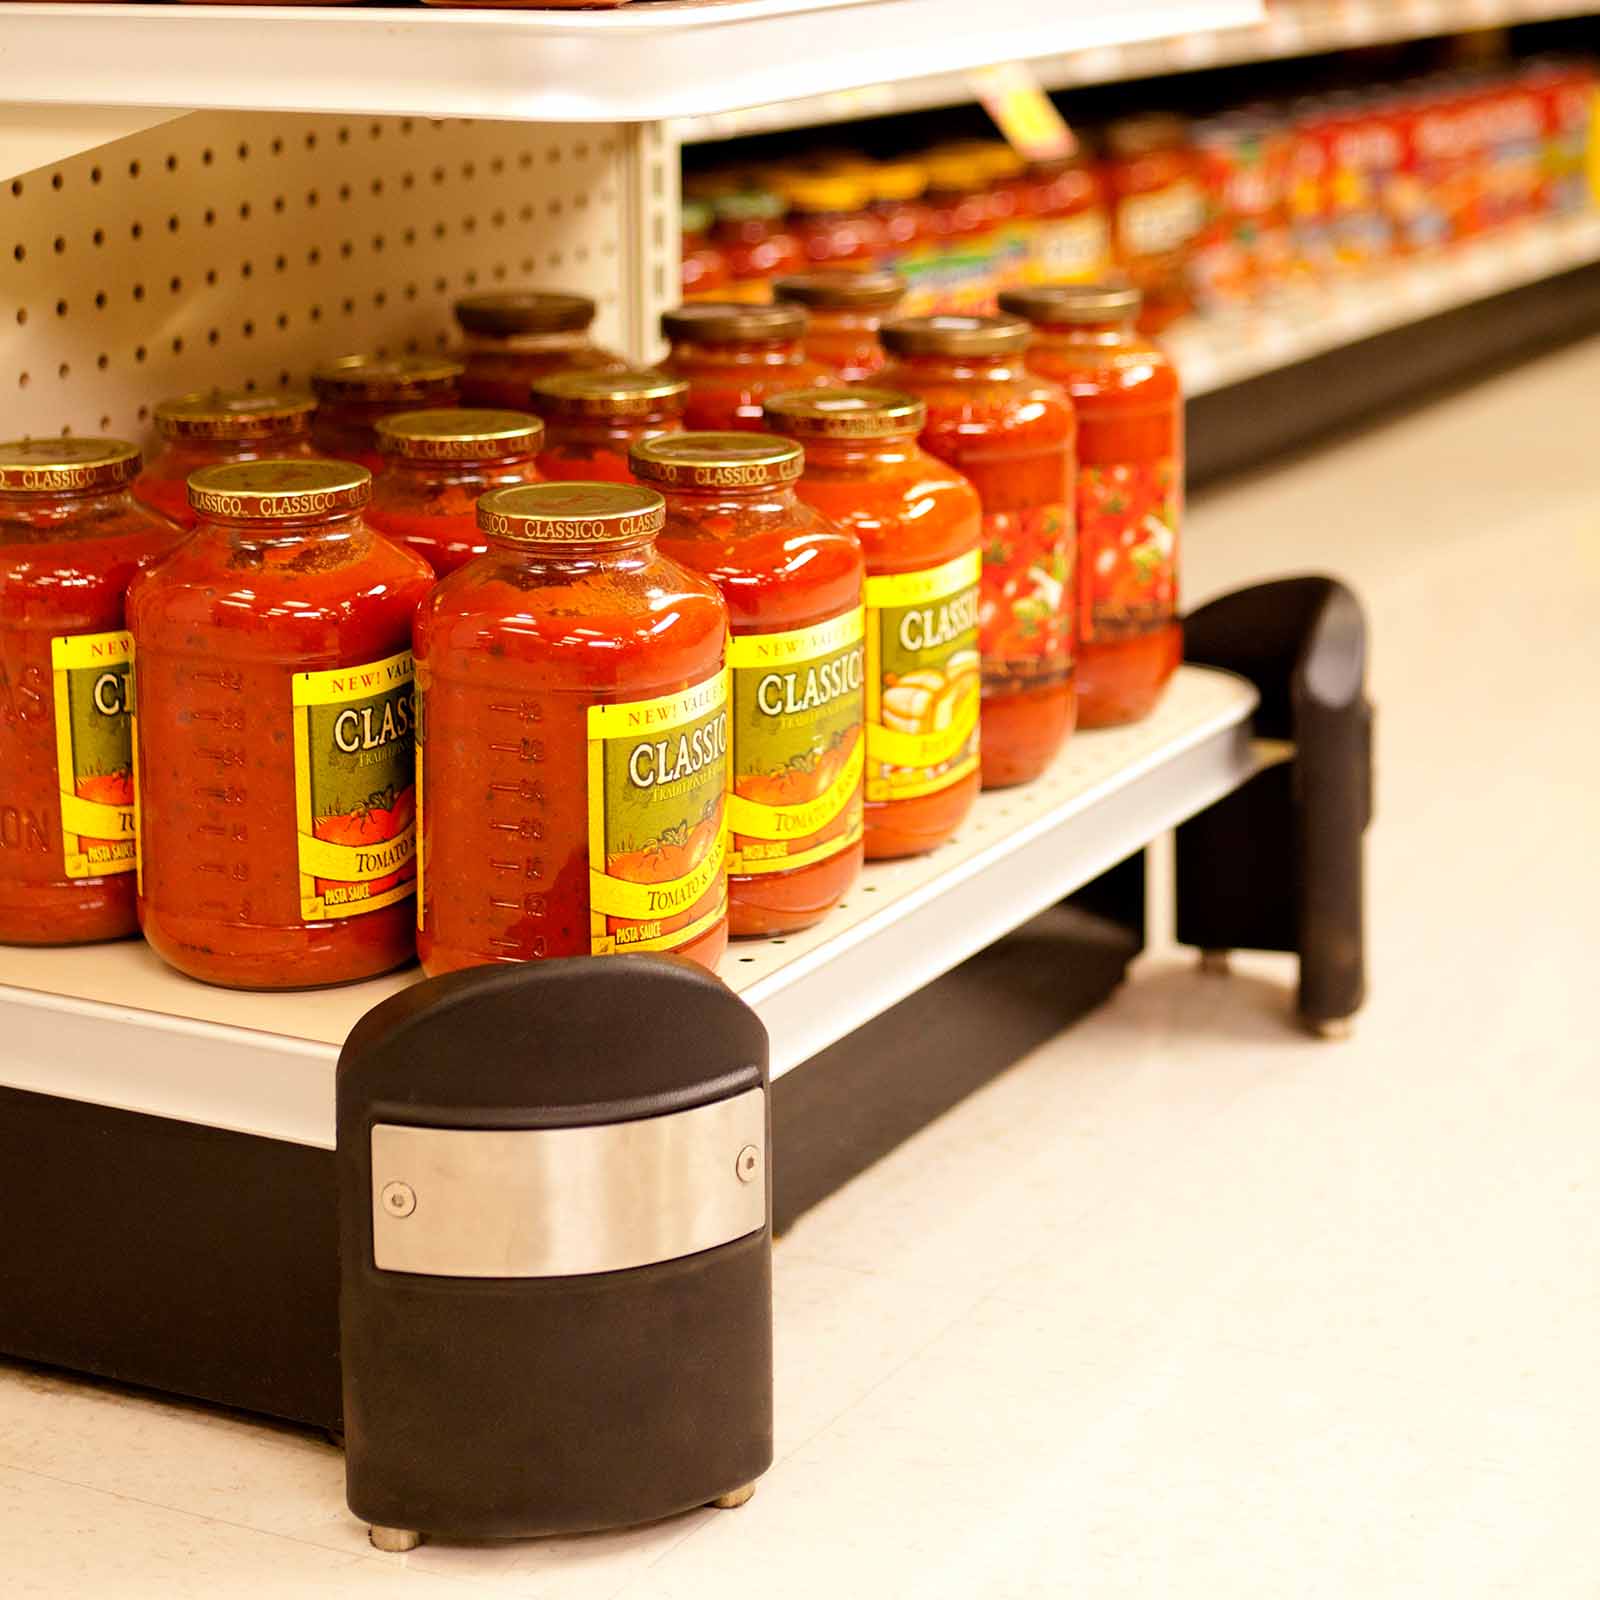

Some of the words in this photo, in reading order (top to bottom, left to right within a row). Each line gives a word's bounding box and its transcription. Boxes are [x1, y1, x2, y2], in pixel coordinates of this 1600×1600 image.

[22, 469, 97, 489] CLASSICO
[695, 465, 767, 486] CLASSICO
[260, 493, 336, 515] CLASSICO
[525, 519, 605, 539] CLASSICO
[332, 672, 380, 694] NEW!
[628, 703, 677, 727] NEW!
[356, 839, 409, 873] TOMATO
[324, 887, 347, 906] PASTA
[348, 882, 370, 903] SAUCE
[648, 877, 700, 912] TOMATO
[616, 926, 639, 944] PASTA
[640, 921, 662, 940] SAUCE
